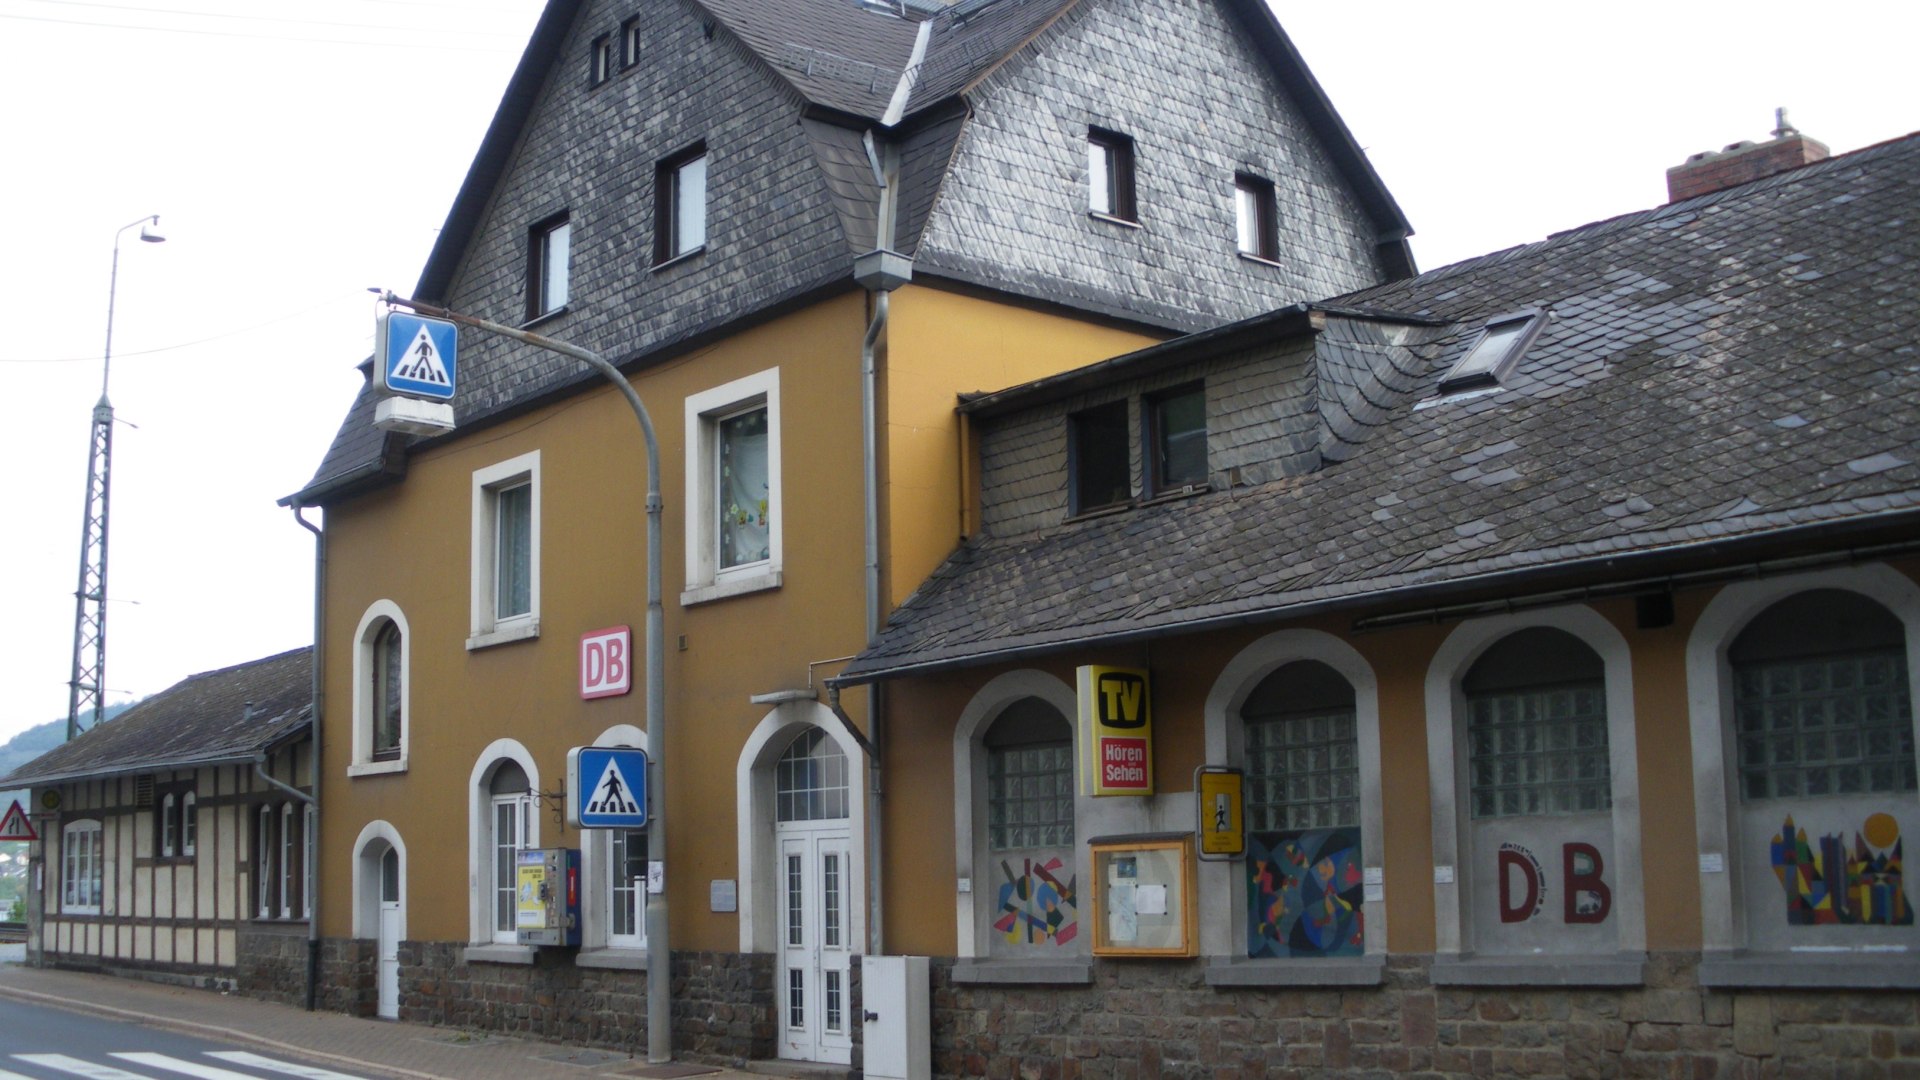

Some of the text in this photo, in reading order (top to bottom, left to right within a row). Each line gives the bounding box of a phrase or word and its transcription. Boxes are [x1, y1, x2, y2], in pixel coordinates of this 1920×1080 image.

[586, 638, 624, 688] DB
[1101, 680, 1142, 721] TV
[1105, 744, 1143, 761] Hören
[1106, 764, 1143, 781] Sehen
